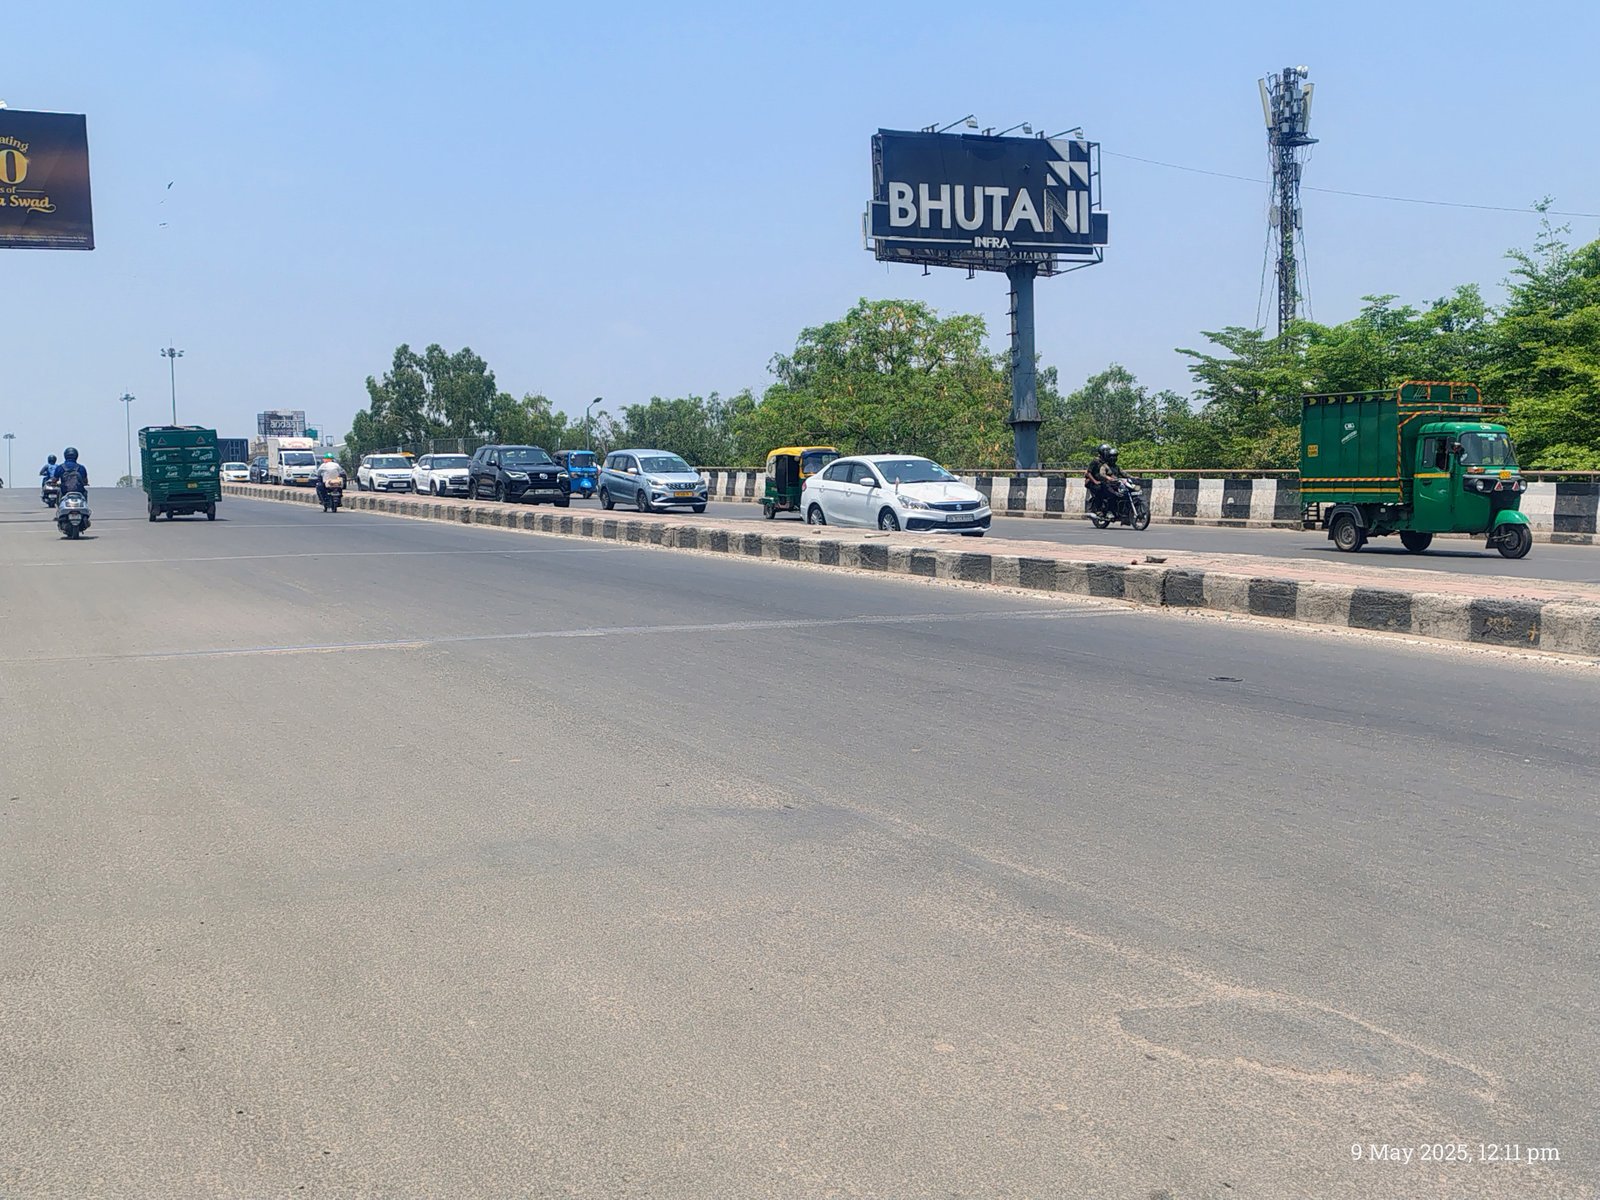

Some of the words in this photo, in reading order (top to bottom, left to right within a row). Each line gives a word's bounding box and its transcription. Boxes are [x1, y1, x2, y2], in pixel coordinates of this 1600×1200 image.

[10, 195, 56, 213] Swad
[888, 182, 1089, 234] BHUTANI
[974, 236, 1010, 249] INFRA
